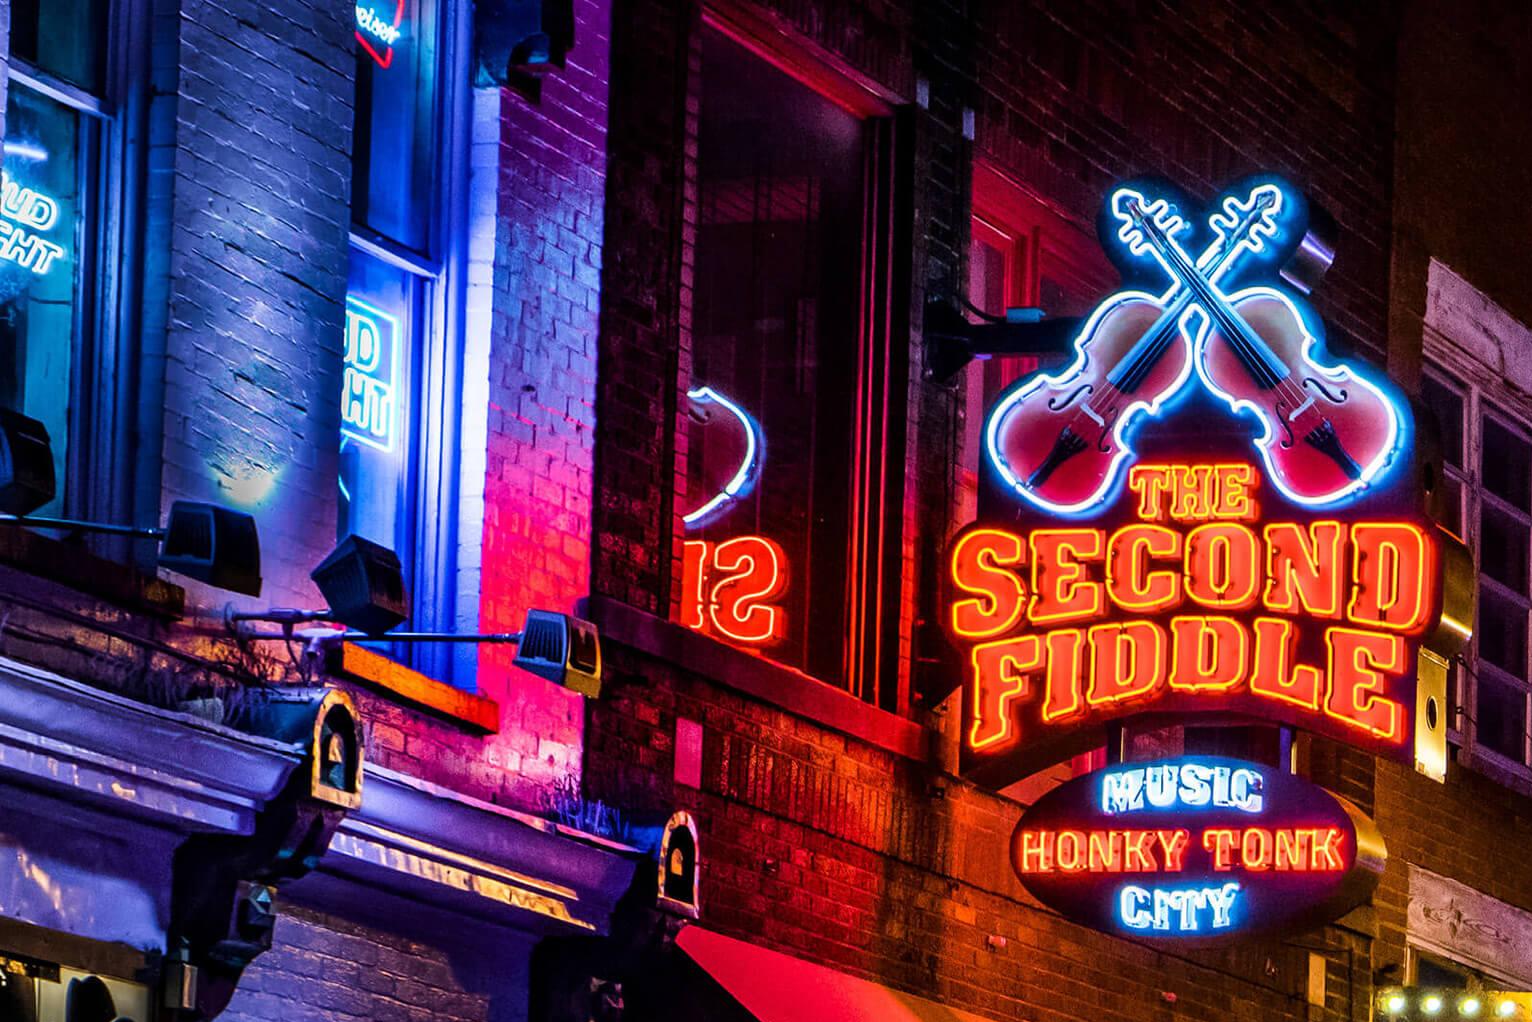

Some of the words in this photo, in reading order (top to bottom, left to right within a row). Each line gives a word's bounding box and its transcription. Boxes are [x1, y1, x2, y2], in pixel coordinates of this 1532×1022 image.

[1129, 464, 1258, 520] THE
[952, 520, 1434, 636] SECOND
[970, 615, 1408, 750] FIDDLE
[1102, 764, 1263, 814] MUSIC
[1021, 829, 1188, 873] HONKY
[1204, 827, 1344, 872] TONK
[1120, 882, 1240, 930] CITY
